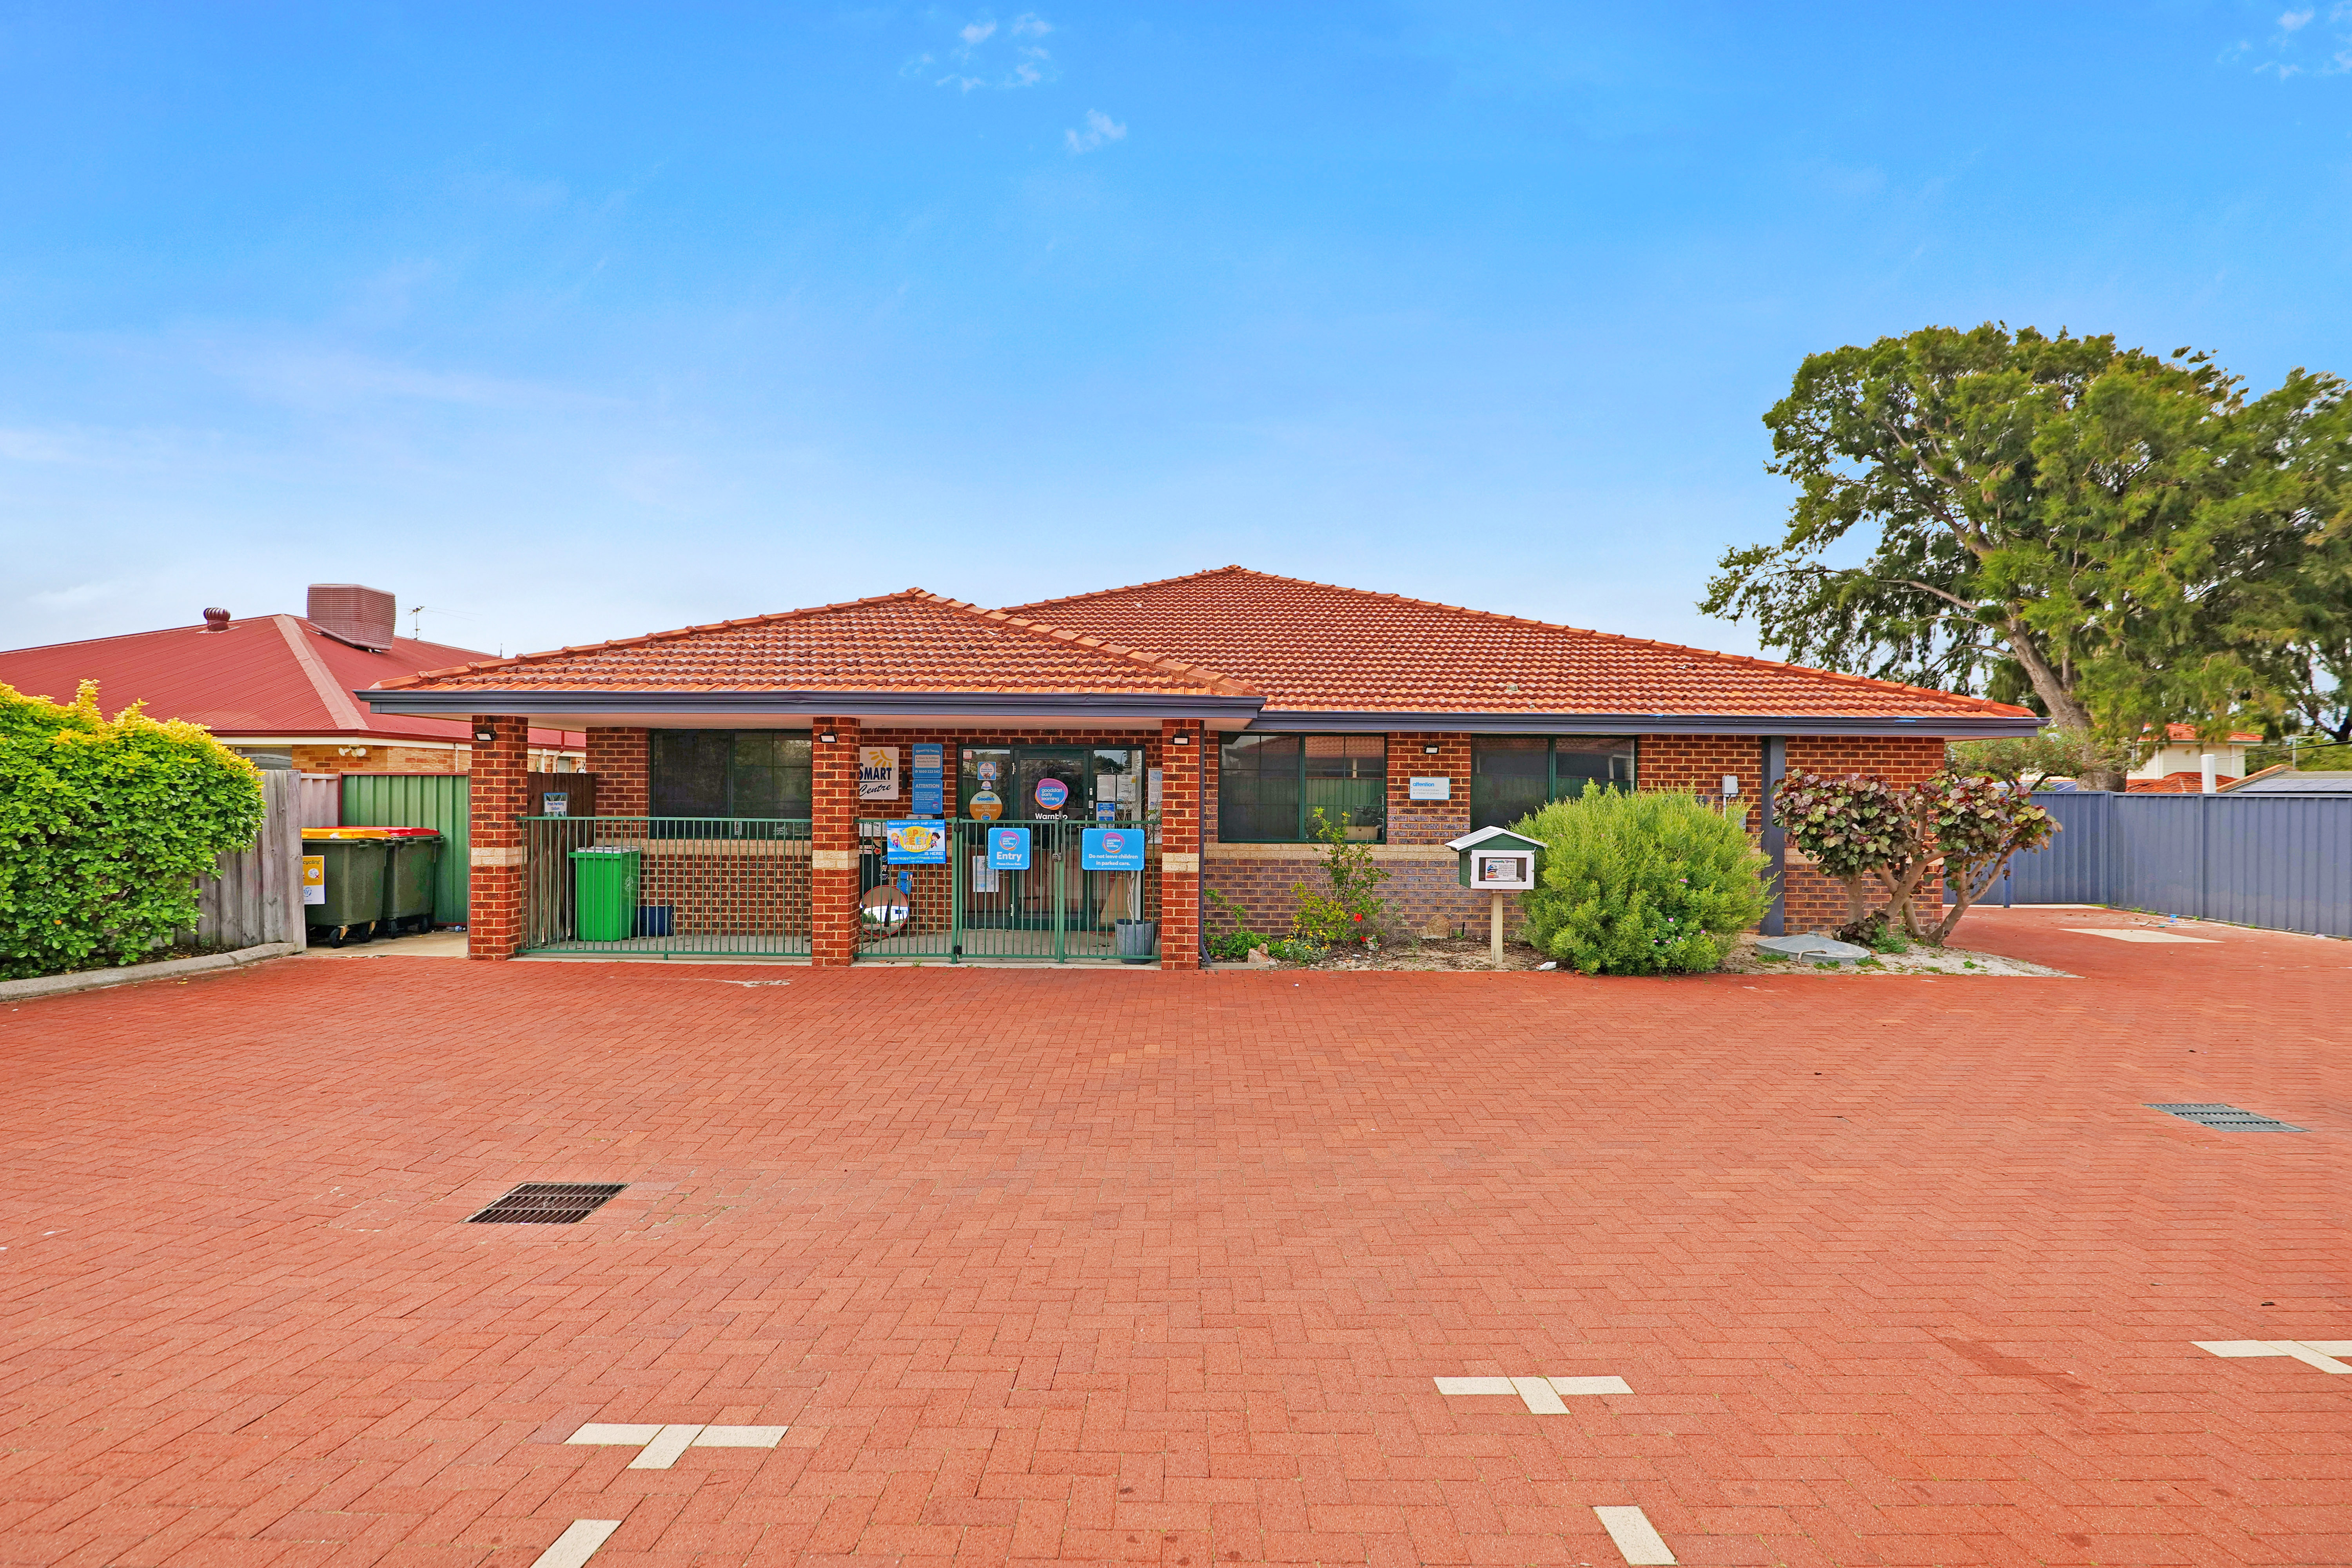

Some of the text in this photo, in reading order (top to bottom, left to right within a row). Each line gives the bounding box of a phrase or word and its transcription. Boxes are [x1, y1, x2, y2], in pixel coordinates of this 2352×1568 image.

[860, 784, 892, 797] Centre
[900, 829, 931, 837] HAPPY
[903, 837, 928, 845] FEET
[996, 851, 1022, 862] Entry
